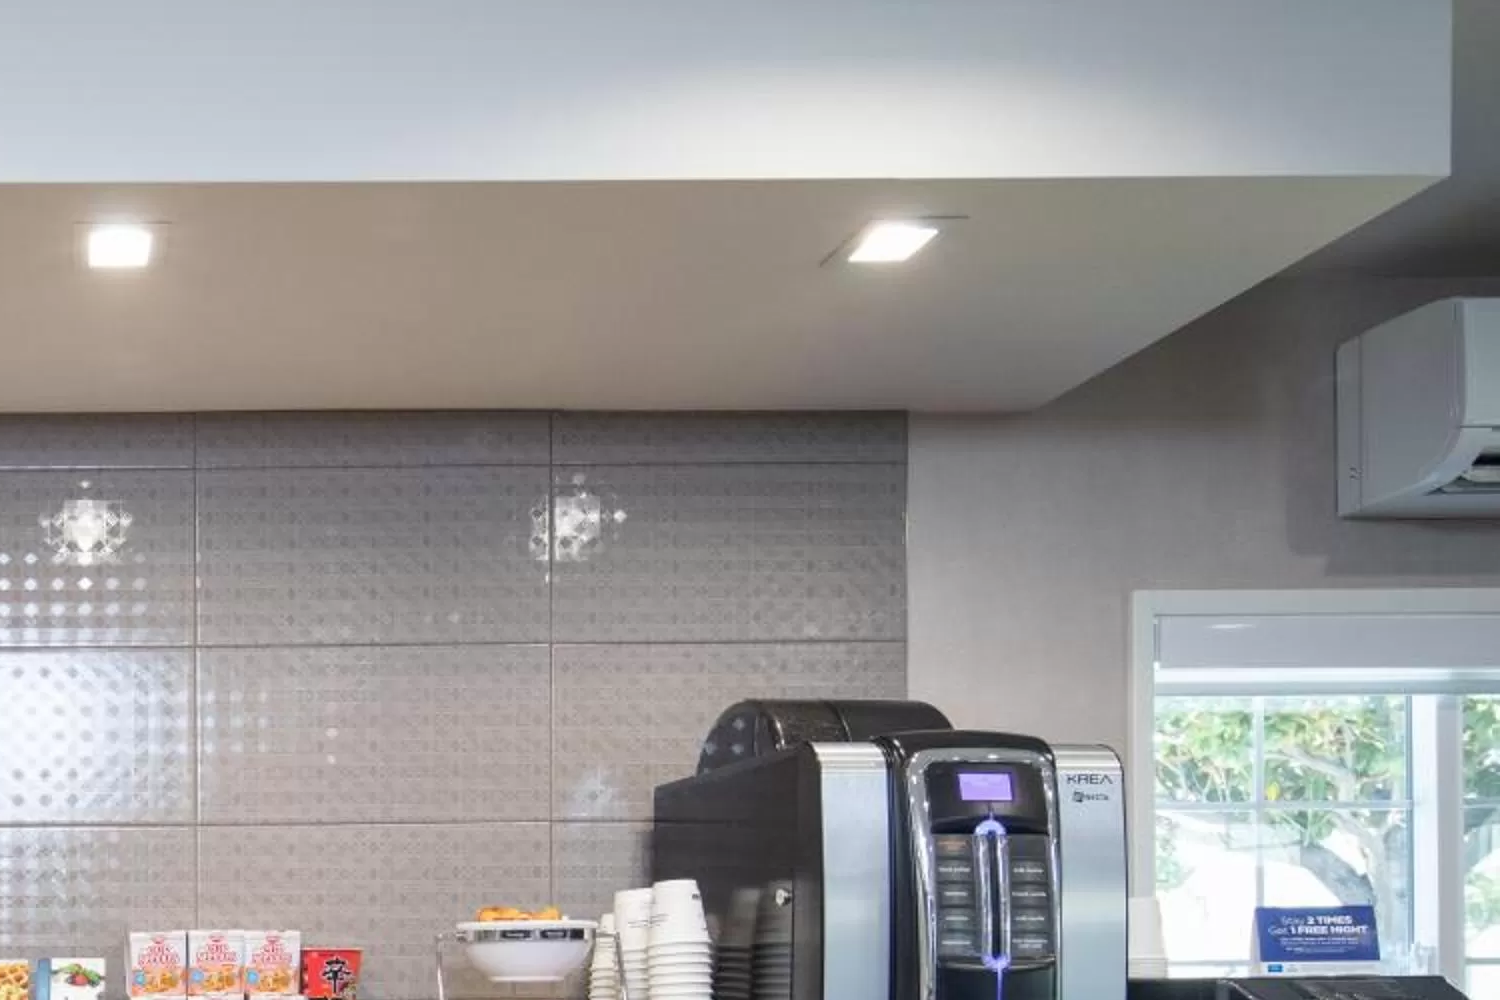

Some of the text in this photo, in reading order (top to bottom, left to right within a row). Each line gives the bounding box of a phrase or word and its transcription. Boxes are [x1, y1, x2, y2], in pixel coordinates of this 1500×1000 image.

[1065, 773, 1114, 785] KREA
[1316, 915, 1353, 925] TIMES
[1298, 925, 1329, 935] FREE
[1330, 925, 1369, 935] NIGHT
[322, 957, 352, 994] 辛
